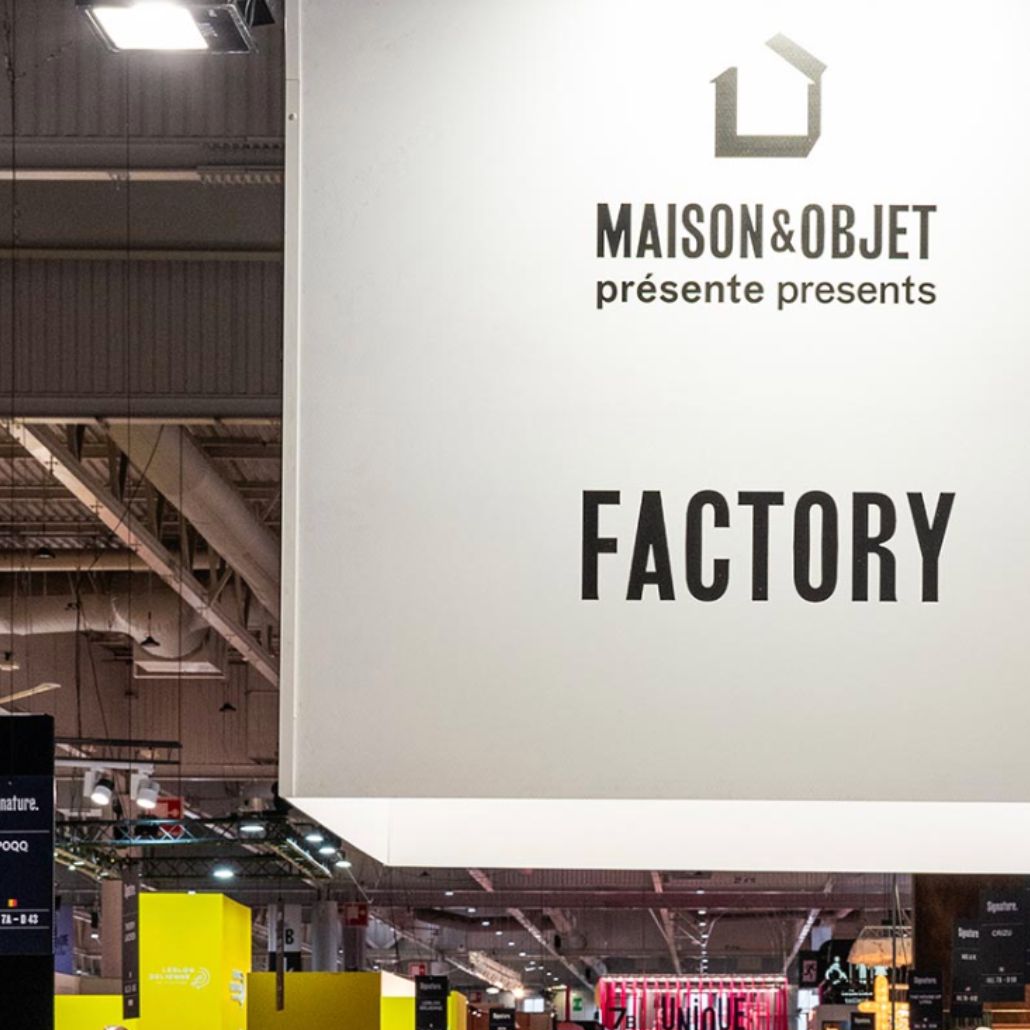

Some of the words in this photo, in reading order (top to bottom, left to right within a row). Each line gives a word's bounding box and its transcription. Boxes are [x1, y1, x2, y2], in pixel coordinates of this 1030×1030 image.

[596, 202, 938, 260] MAISON&OBJET
[596, 272, 765, 310] présente
[777, 274, 938, 311] presents
[581, 488, 957, 603] FACTORY
[1, 914, 12, 924] 7A
[28, 914, 38, 924] 43
